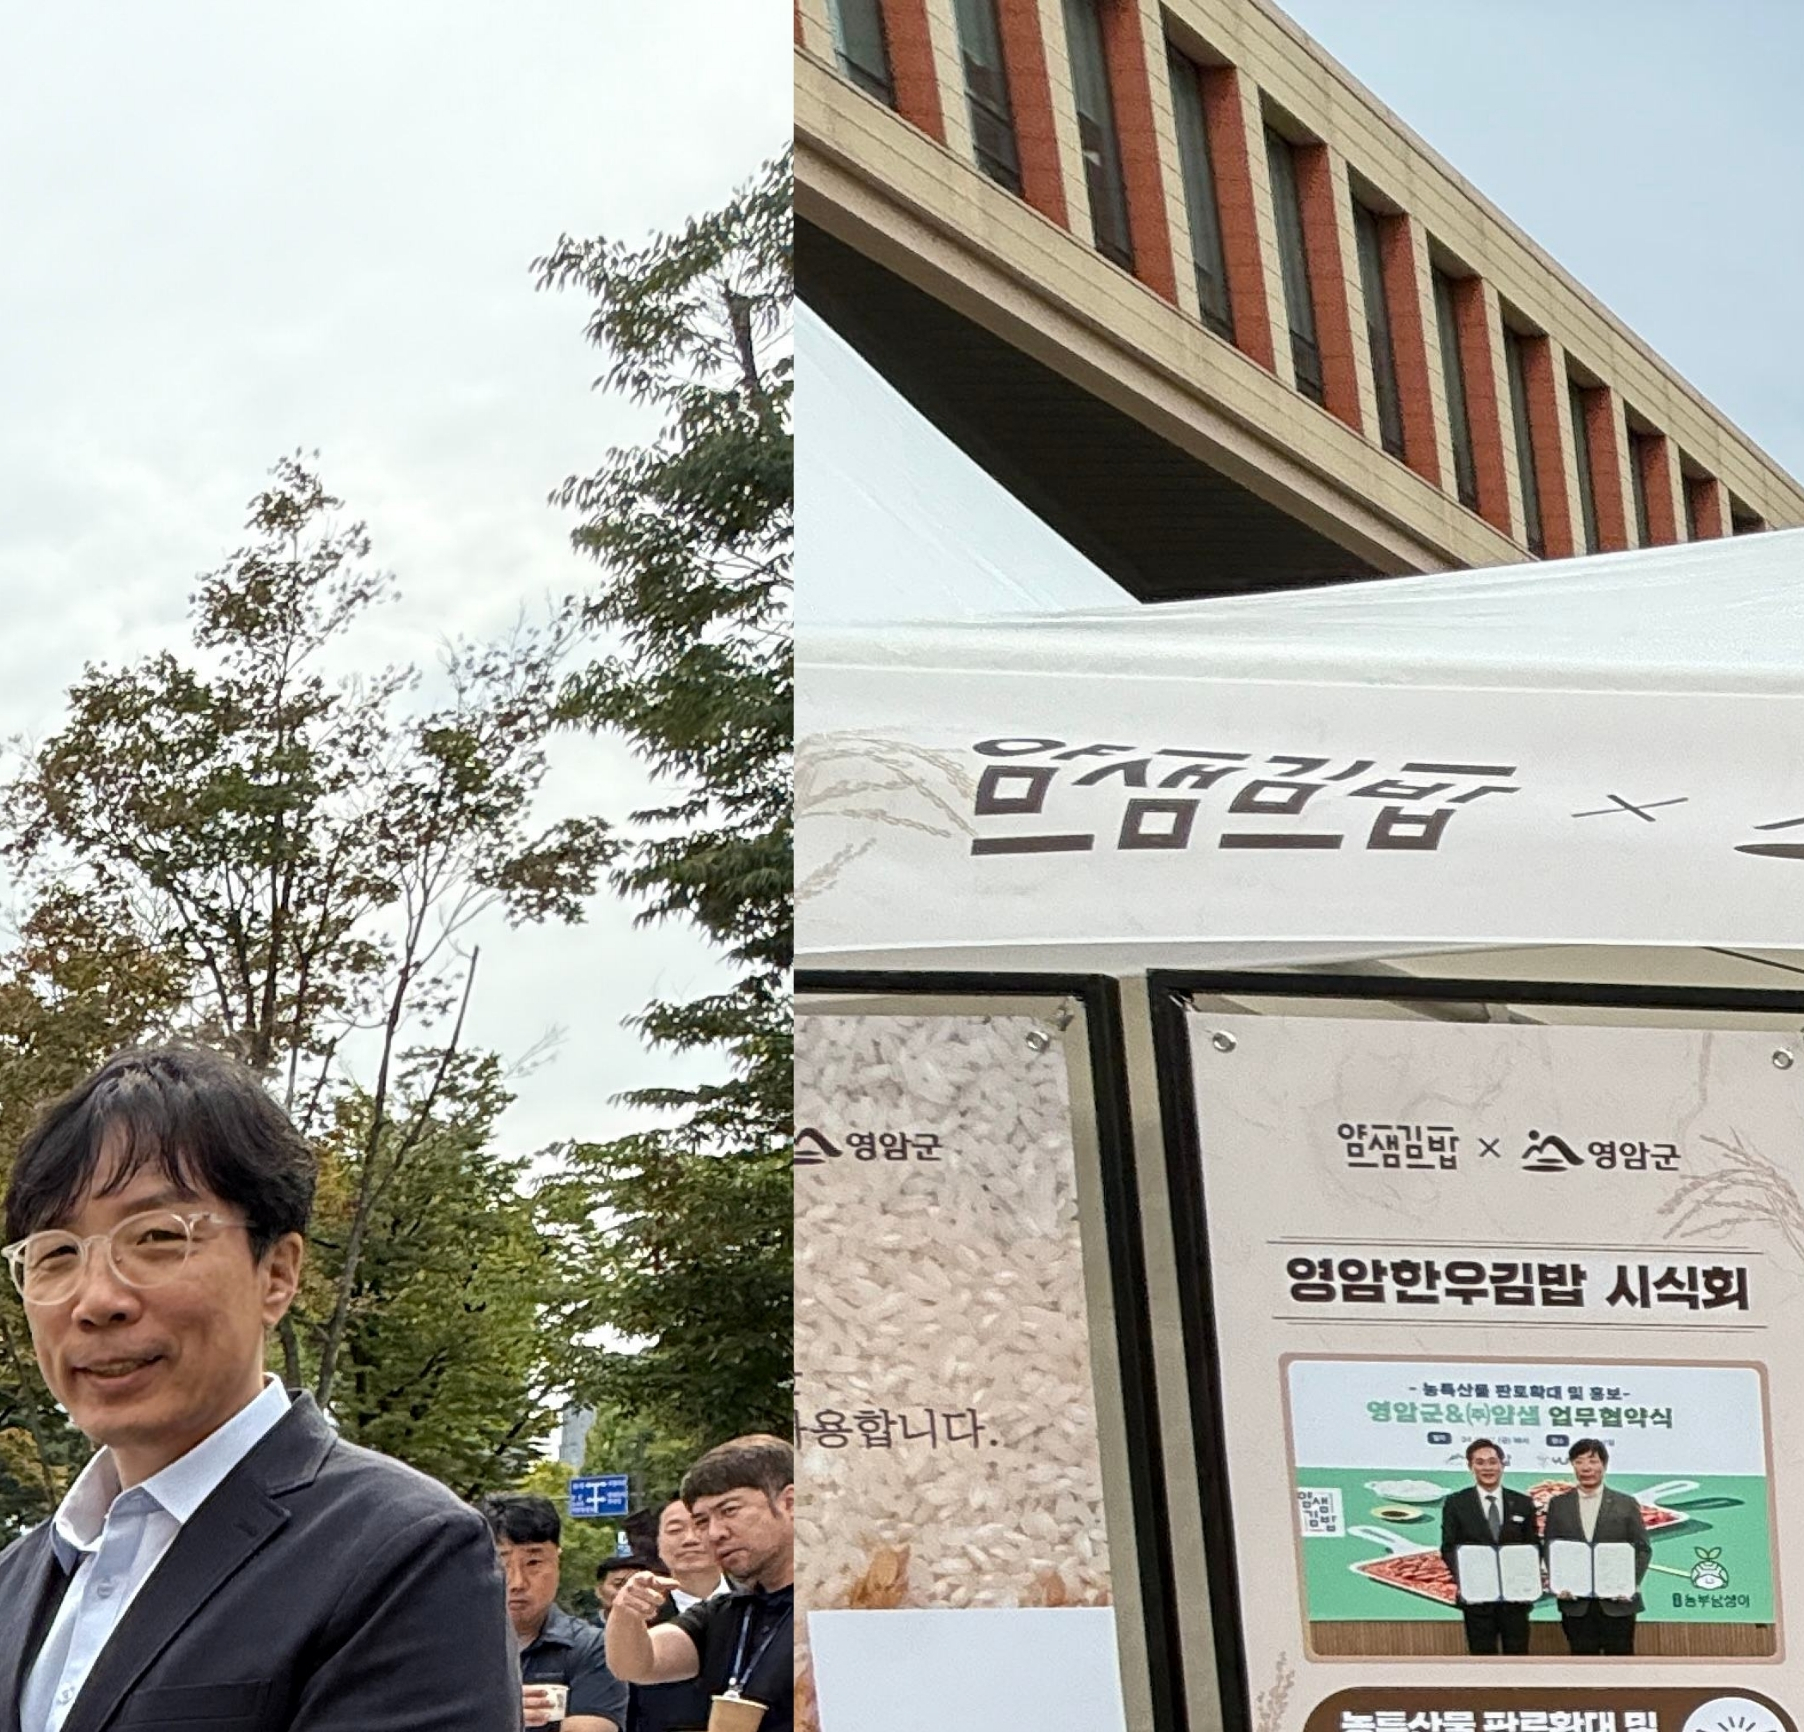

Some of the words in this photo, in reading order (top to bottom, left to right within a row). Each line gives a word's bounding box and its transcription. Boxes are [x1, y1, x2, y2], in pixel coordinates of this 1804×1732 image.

[972, 737, 1518, 856] 얌샘김밥
[845, 1132, 943, 1162] 영암군
[1337, 1123, 1460, 1171] 얌샘김밥
[1587, 1140, 1681, 1172] 영암군
[1286, 1256, 1587, 1308] 영암한우김밥
[1605, 1264, 1750, 1310] 시식회
[793, 1408, 1000, 1450] 용합니다.
[1549, 1406, 1673, 1429] 업무협약식
